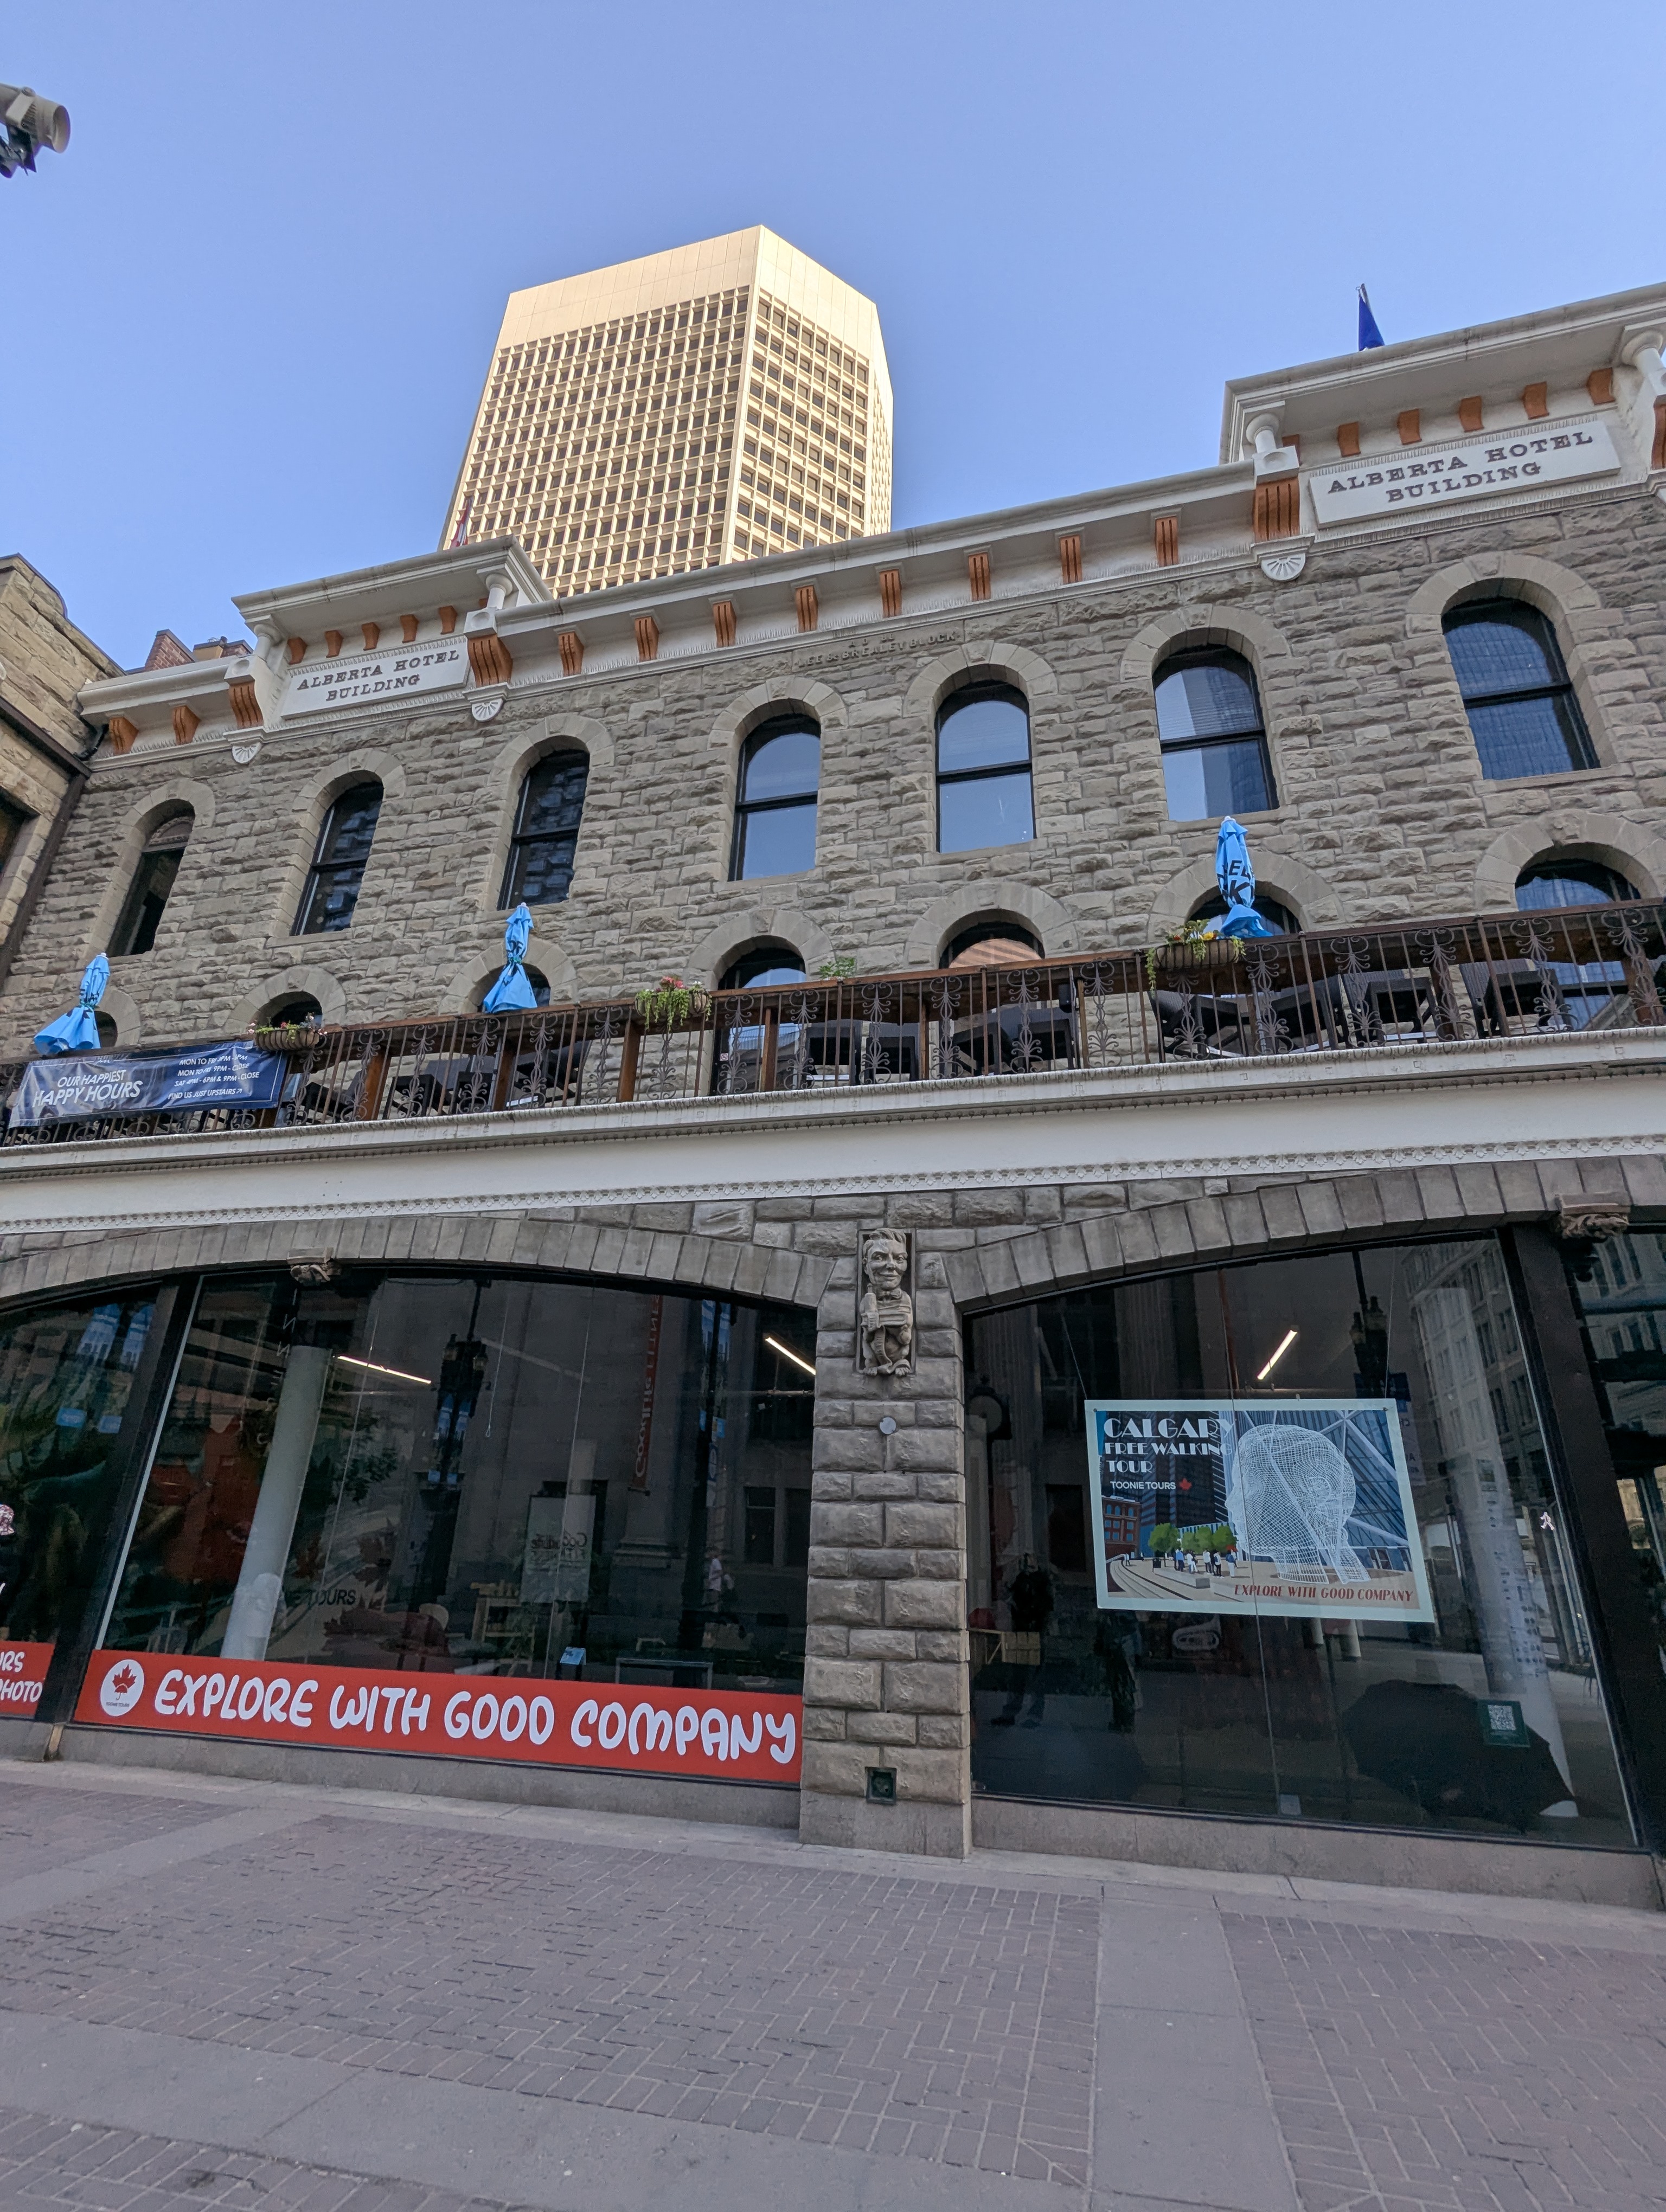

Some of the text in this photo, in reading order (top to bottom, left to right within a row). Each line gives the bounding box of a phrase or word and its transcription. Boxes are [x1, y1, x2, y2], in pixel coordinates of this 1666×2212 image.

[1328, 432, 1593, 494] ALBERTA HOTEL
[1386, 461, 1542, 503] BUILDING
[798, 654, 823, 668] LEE
[908, 631, 956, 648] BLOCK
[297, 650, 460, 690] ALBERTA HOTEL
[325, 674, 421, 702] BUILDING
[179, 1058, 197, 1066] MON
[232, 1063, 250, 1071] CLOSE
[57, 1069, 127, 1088] OUR HAPPIEST
[240, 1071, 260, 1081] CLOSE
[32, 1081, 144, 1108] HAPPY HOURS
[168, 1088, 236, 1100] FIND US JUST UPSTAIRS
[1104, 1418, 1237, 1438] CALGARY
[1105, 1442, 1233, 1456] FREE WALKING
[1106, 1460, 1153, 1474] TOUR
[1110, 1481, 1176, 1490] TOONIE TOURS
[1234, 1584, 1414, 1602] EXPLORE WITH GOOD COMPANY
[155, 1669, 796, 1764] EXPLORE WITH GOOD COMPANY
